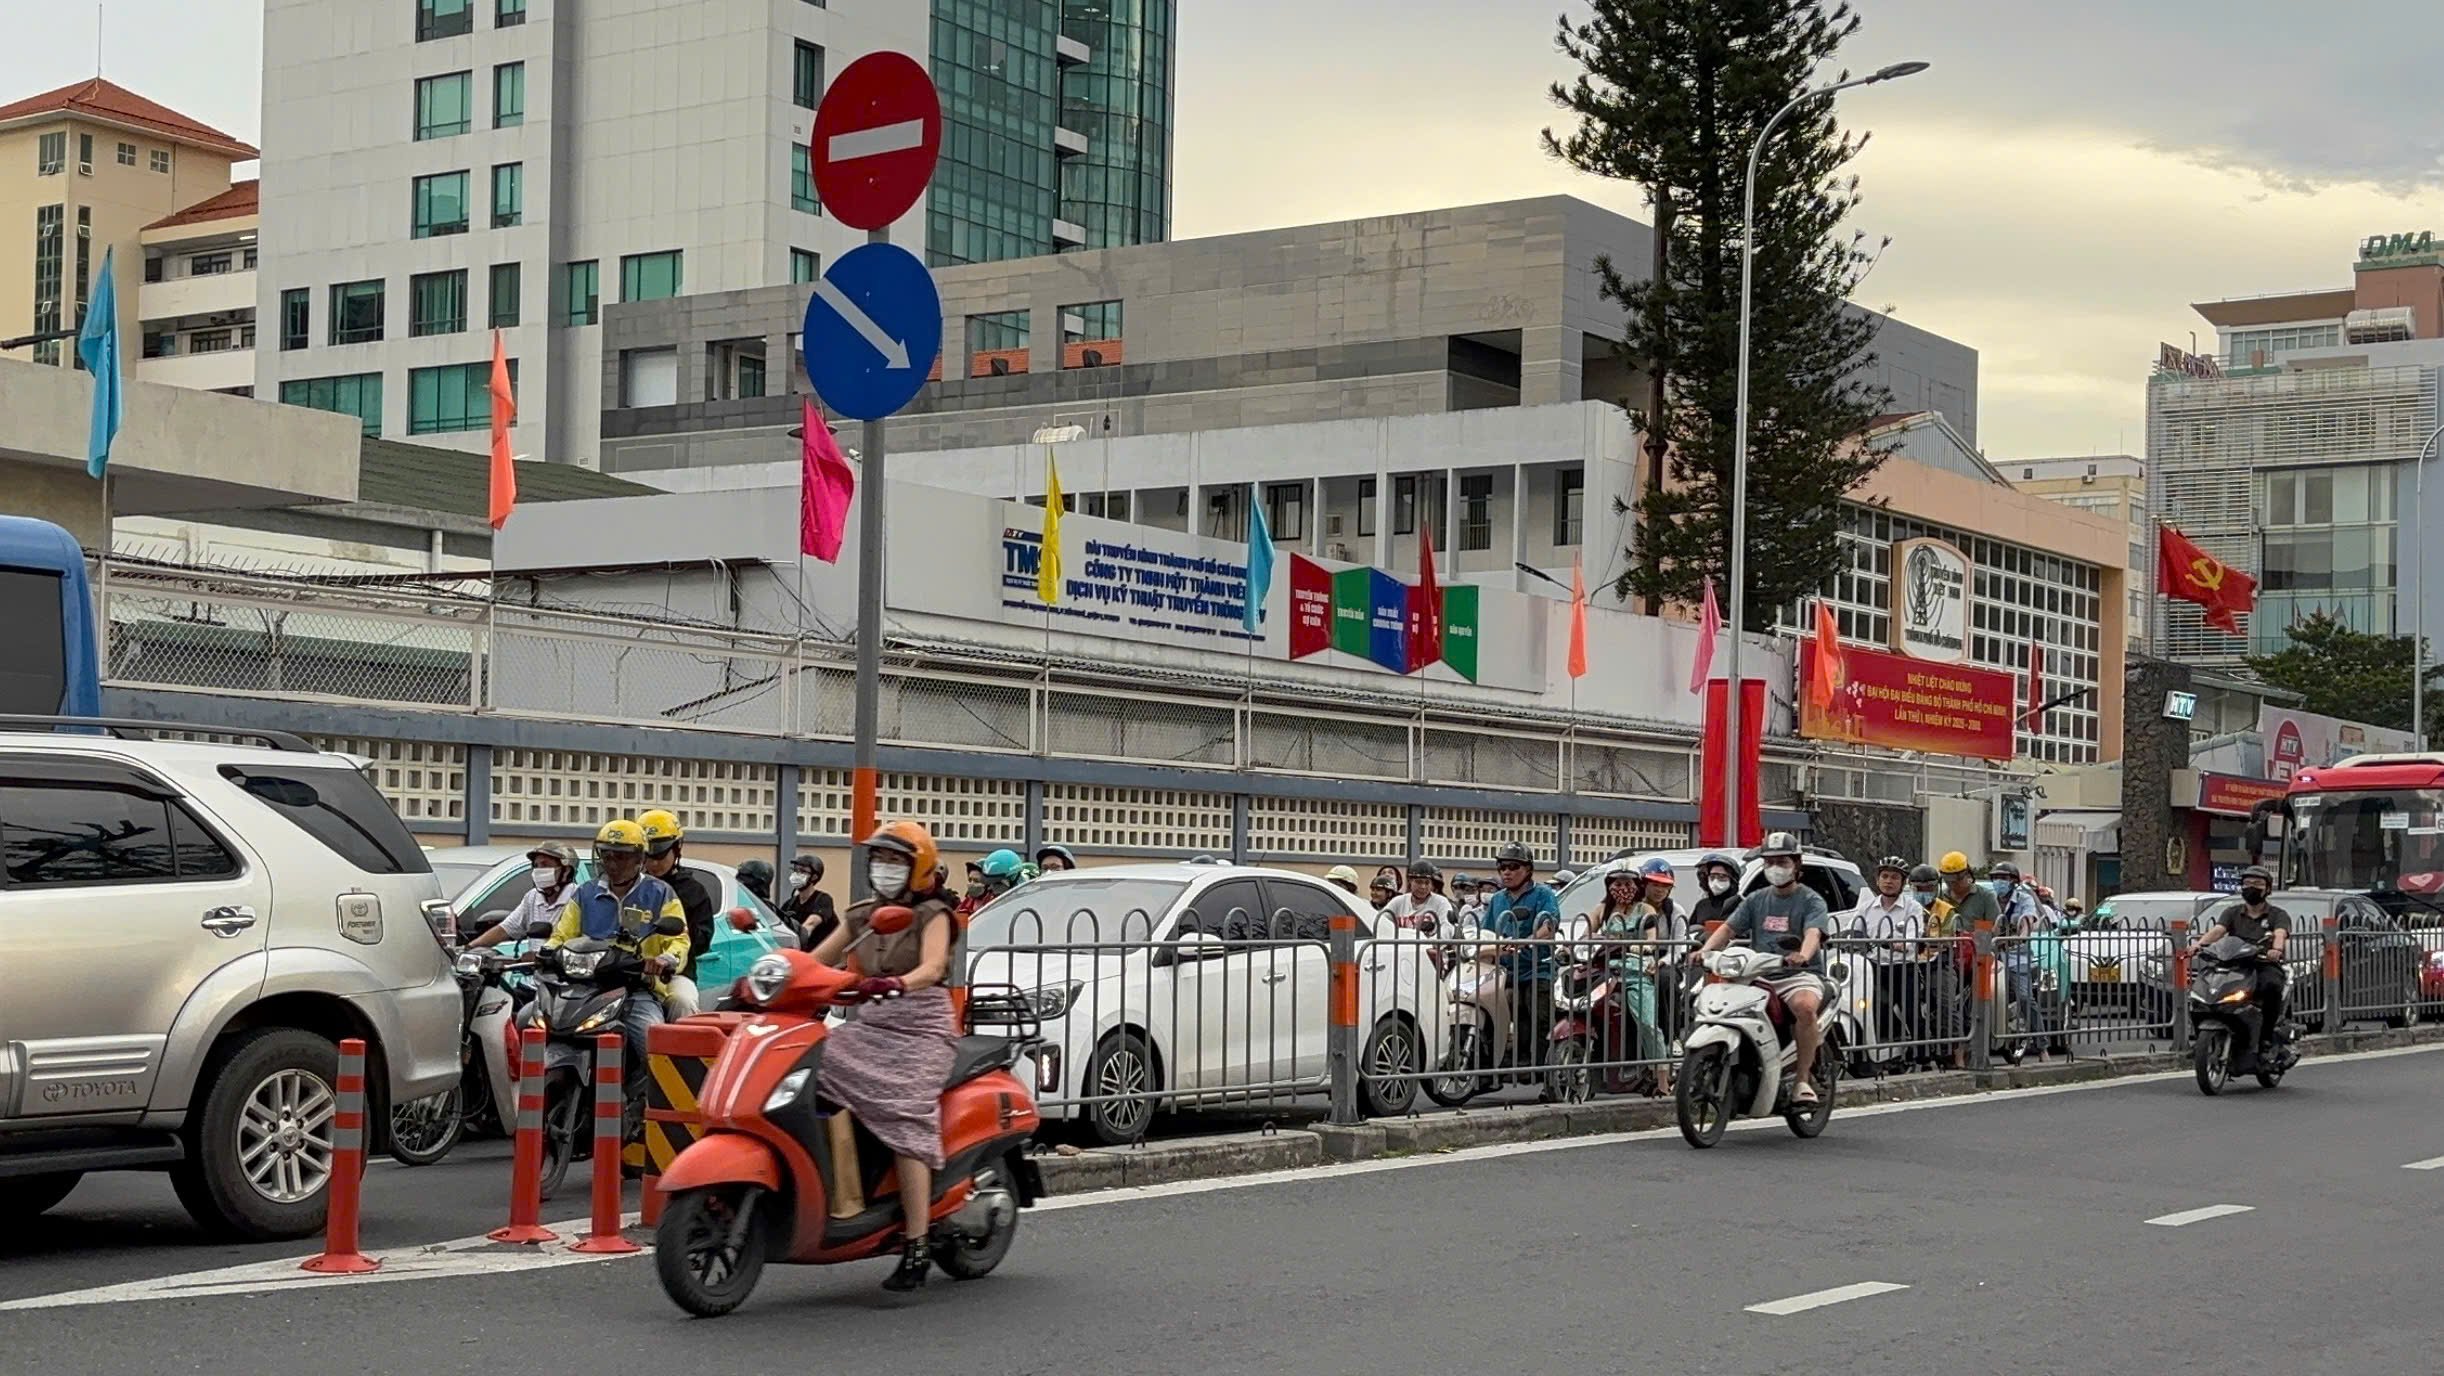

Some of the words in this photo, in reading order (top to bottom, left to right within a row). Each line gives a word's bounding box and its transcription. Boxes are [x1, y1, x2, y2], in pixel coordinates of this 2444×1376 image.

[1003, 541, 1042, 575] TM
[1085, 558, 1116, 580] CÔNG
[1117, 565, 1133, 583] TY
[1189, 576, 1225, 597] THÀNH
[1066, 579, 1093, 601] DỊCH
[1094, 583, 1111, 605] VỤ
[1129, 589, 1166, 612] THUẬT
[1166, 593, 1209, 615] TRUYỀN
[1210, 600, 1244, 620] THÔNG
[72, 1080, 136, 1098] TOYOTA
